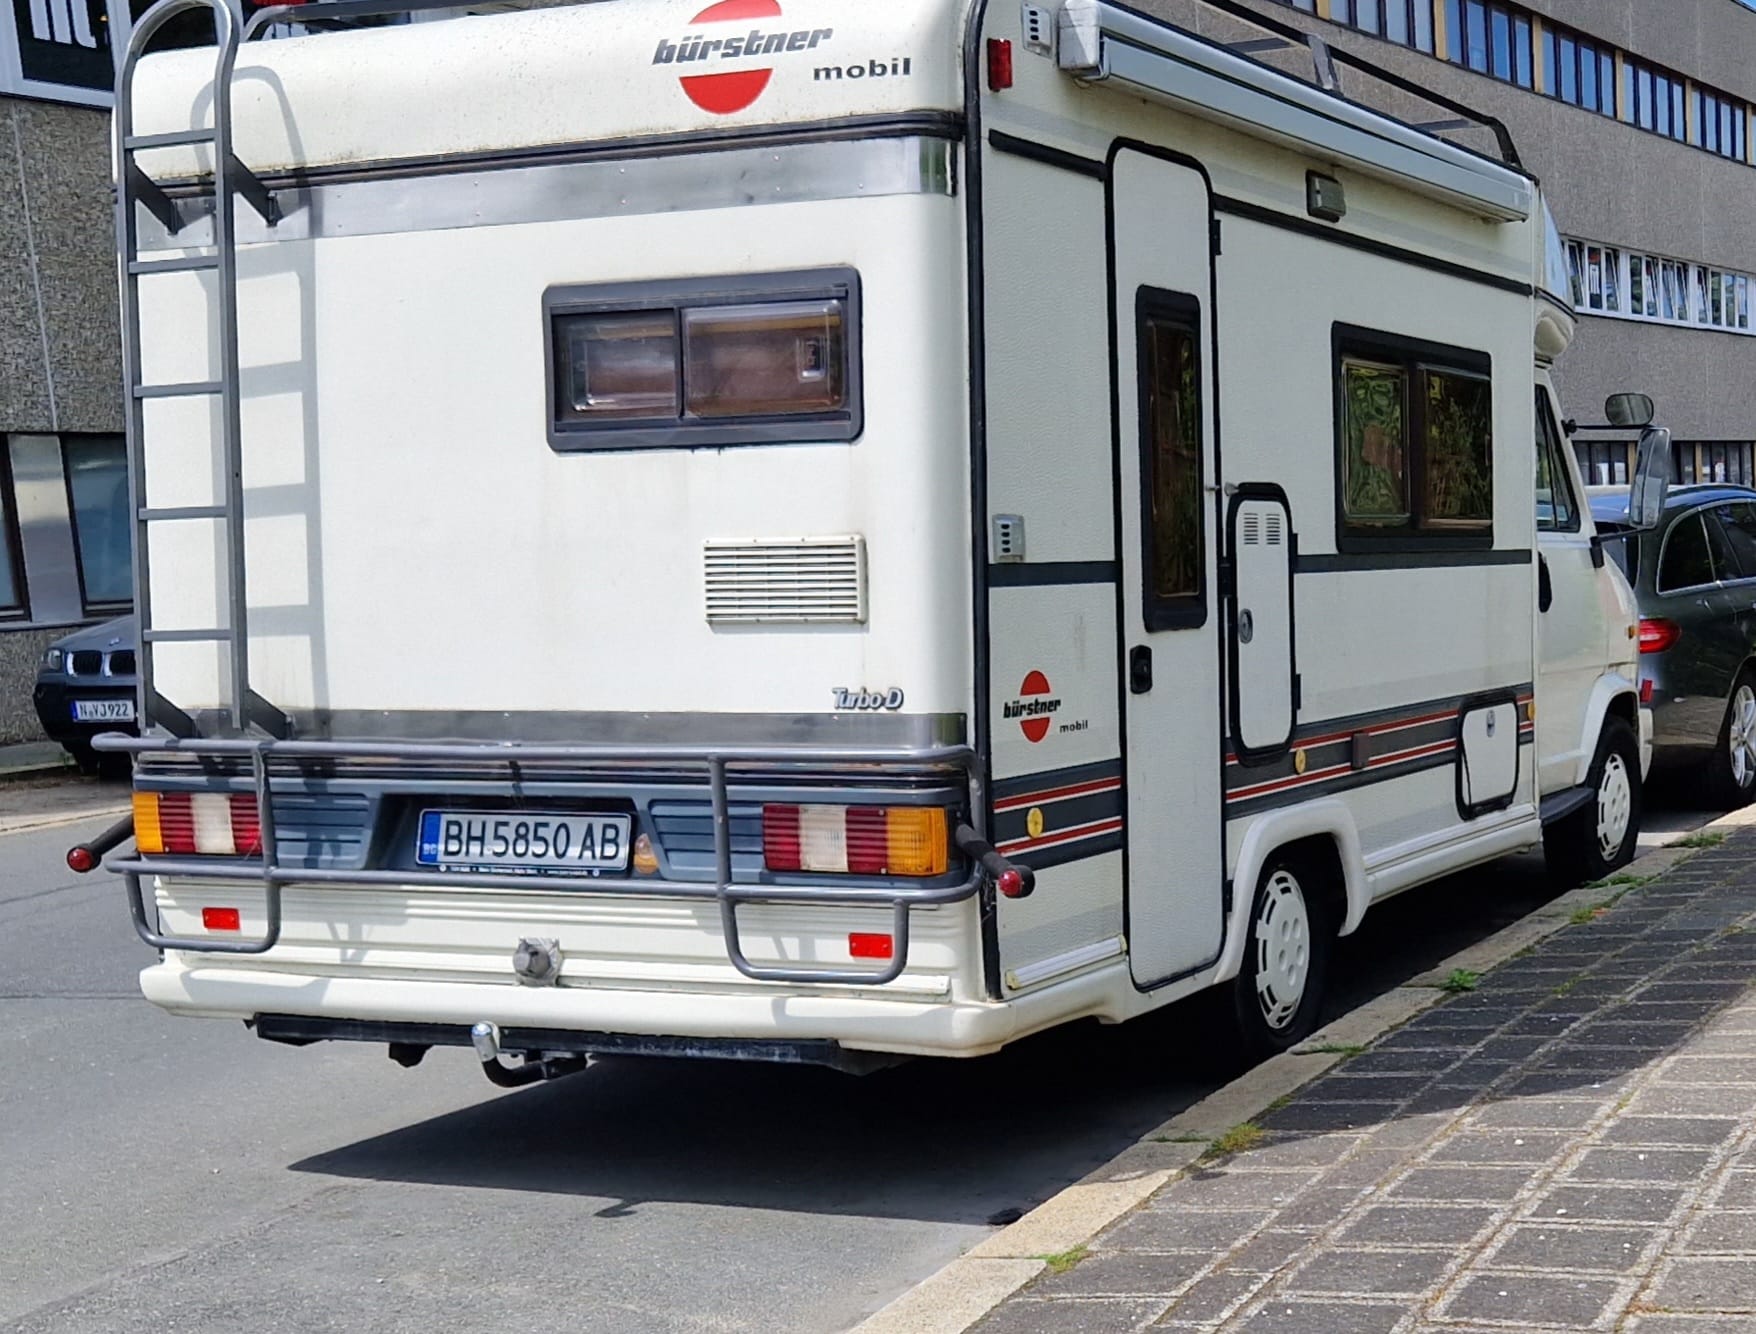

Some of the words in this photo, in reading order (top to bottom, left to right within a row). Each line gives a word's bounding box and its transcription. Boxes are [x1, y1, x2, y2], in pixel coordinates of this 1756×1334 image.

[652, 28, 834, 65] bürstner
[813, 57, 912, 81] mobil
[1003, 698, 1062, 719] bürstner
[1060, 719, 1089, 733] mobil
